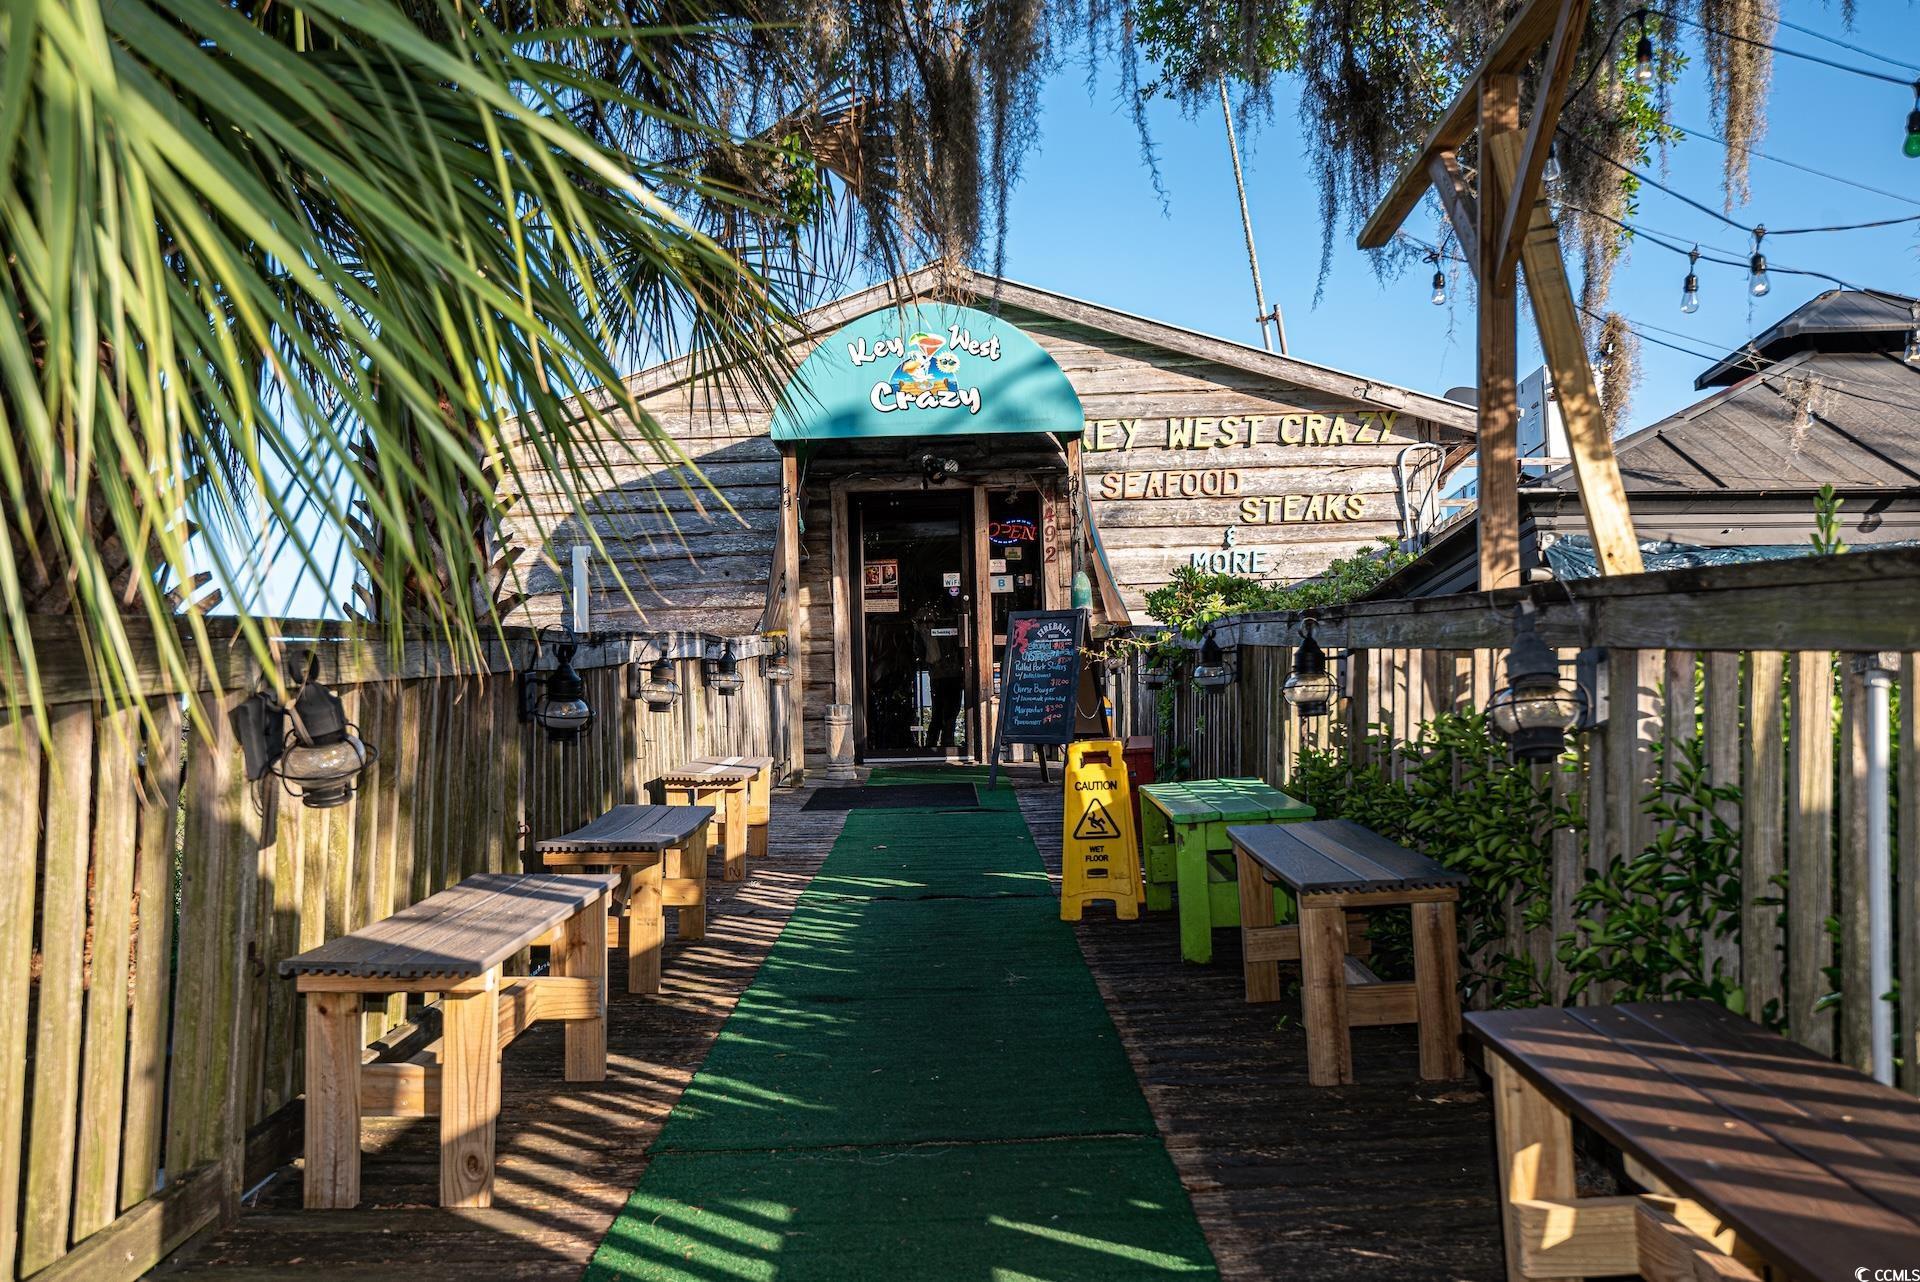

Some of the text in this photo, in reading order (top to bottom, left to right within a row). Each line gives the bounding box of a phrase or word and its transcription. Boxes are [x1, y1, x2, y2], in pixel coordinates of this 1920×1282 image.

[847, 324, 1001, 367] Key West
[869, 381, 982, 415] Crazy
[1166, 415, 1265, 448] WEST
[1279, 411, 1400, 446] CRAZY
[1100, 470, 1242, 499] SEAFOOD
[1240, 494, 1365, 524] STEAKS
[989, 522, 1037, 541] OPEN
[1225, 525, 1237, 547] &
[1190, 551, 1268, 575] MORE
[1033, 661, 1046, 672] Pork
[1074, 780, 1118, 792] CAUTION
[1085, 854, 1109, 863] FLOOR
[1089, 845, 1105, 853] WET
